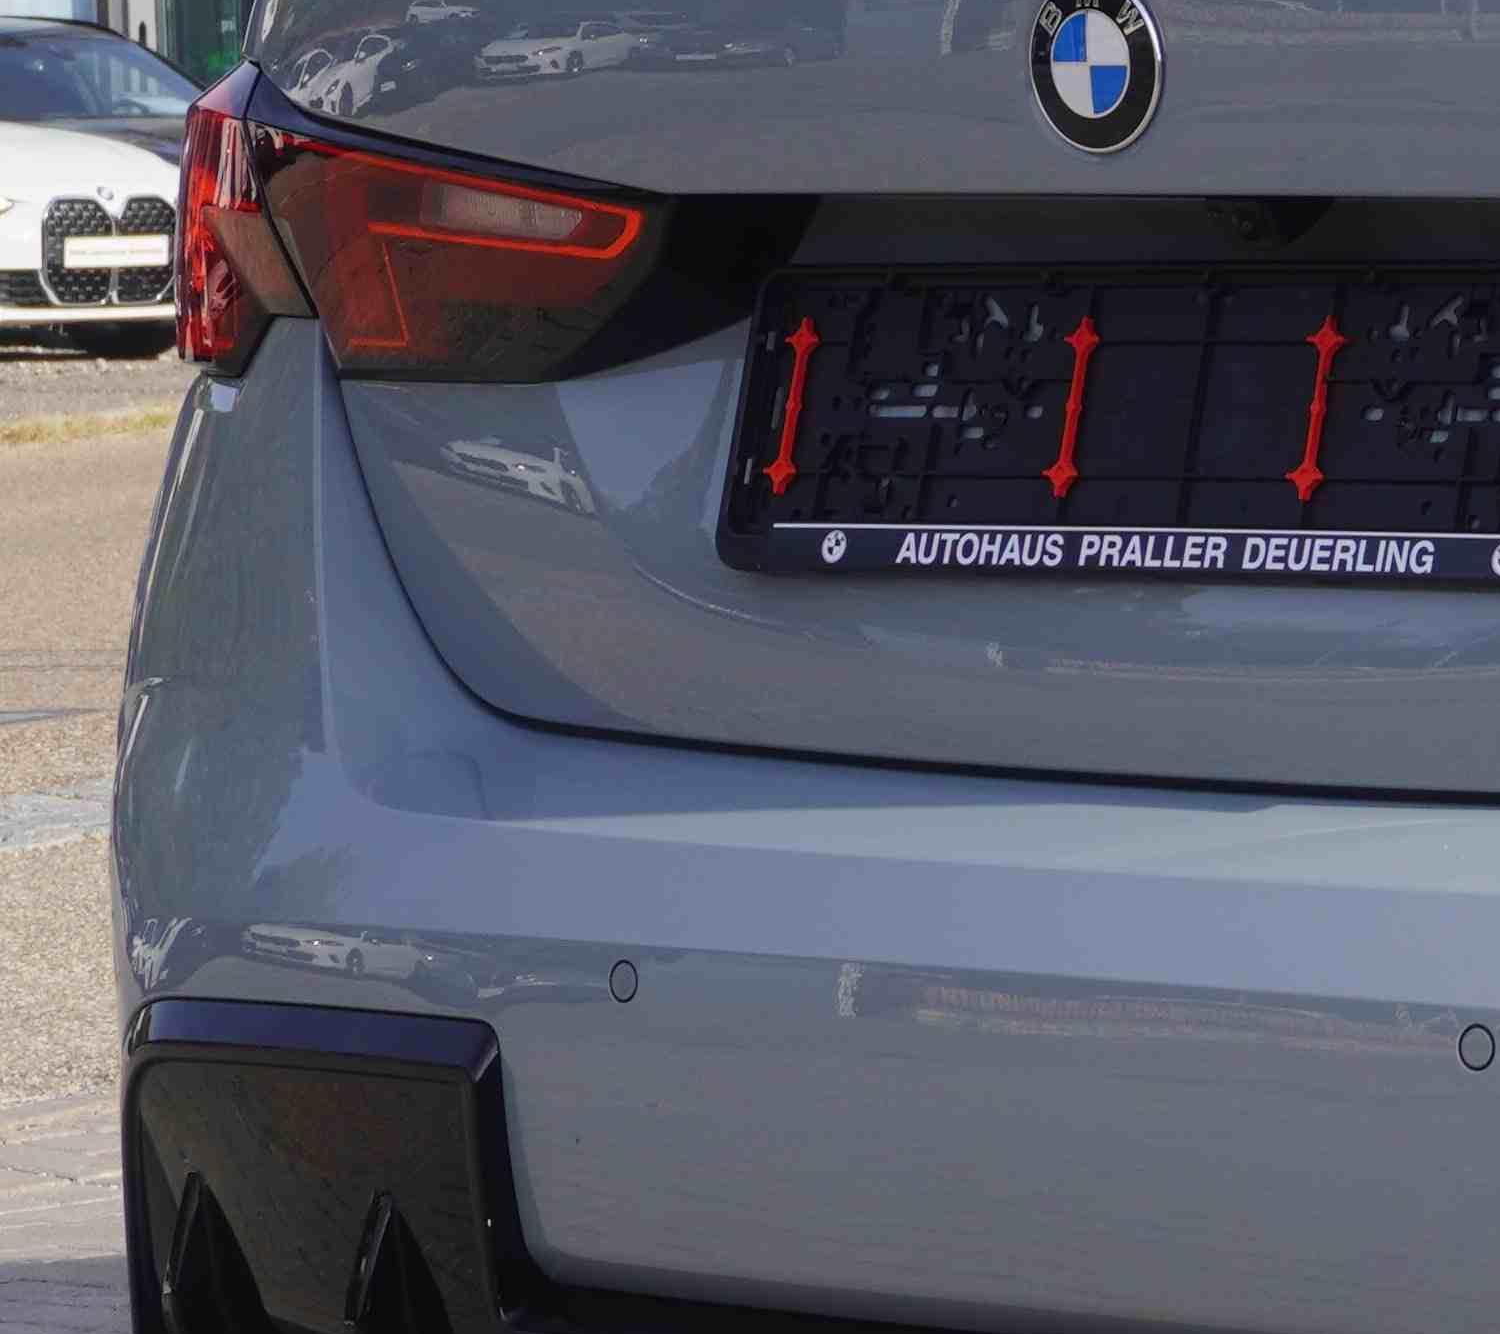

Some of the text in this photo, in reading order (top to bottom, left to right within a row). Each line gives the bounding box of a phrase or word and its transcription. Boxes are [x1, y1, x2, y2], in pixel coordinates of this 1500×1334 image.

[896, 532, 1436, 574] AUTOHAUS PRALLER DEUERLING
